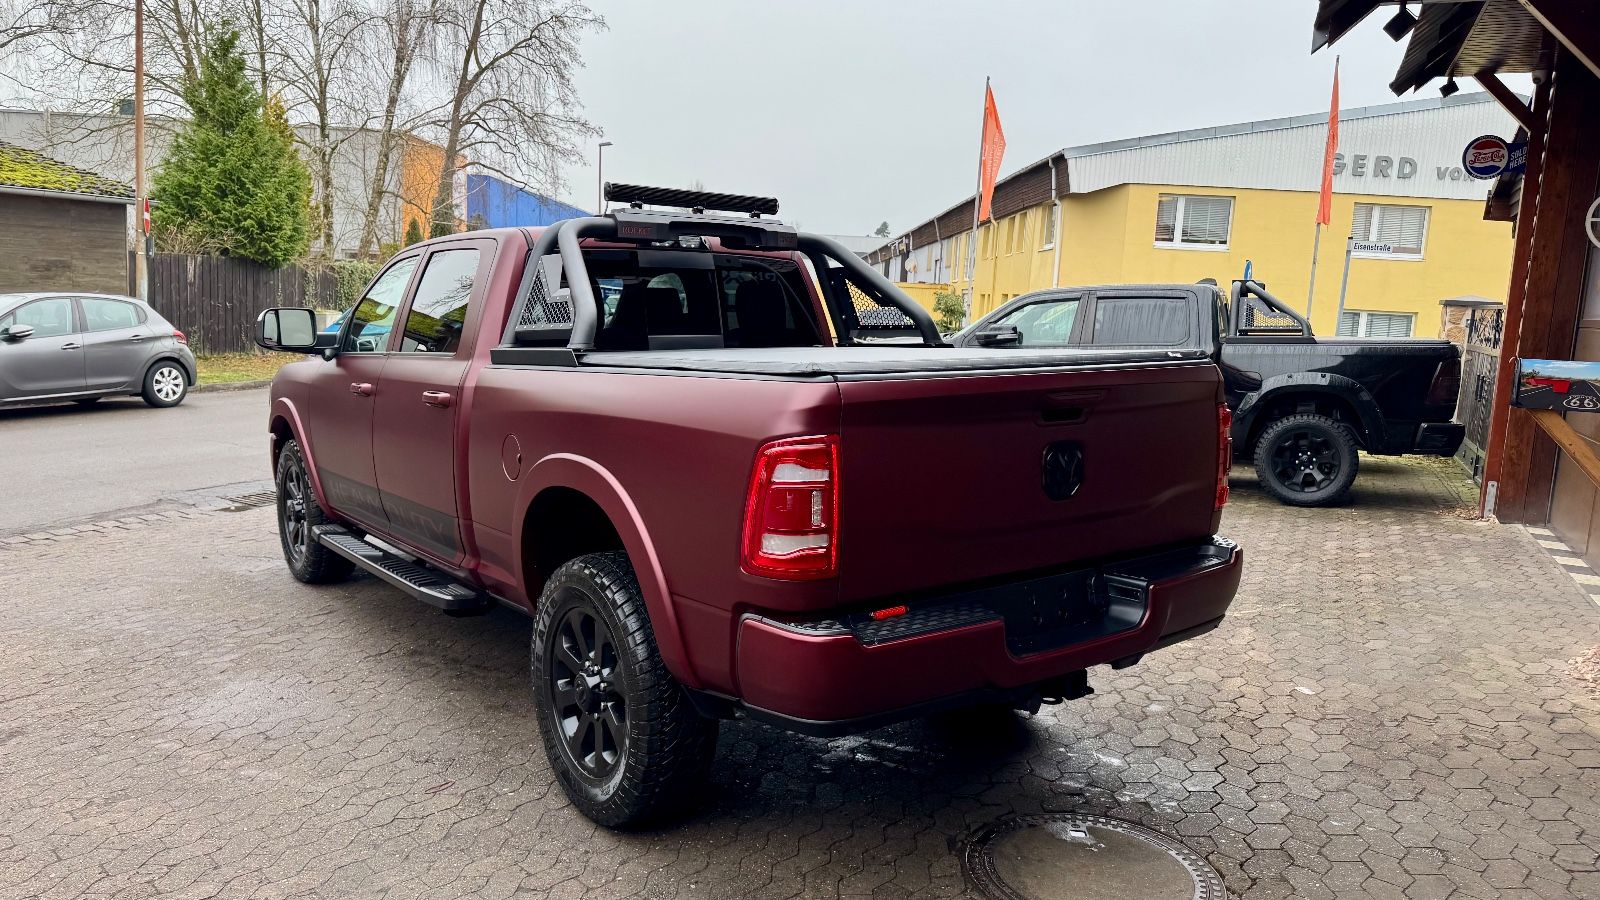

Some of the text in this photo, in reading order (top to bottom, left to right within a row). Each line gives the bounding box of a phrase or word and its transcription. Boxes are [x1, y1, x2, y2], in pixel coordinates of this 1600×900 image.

[1511, 147, 1528, 160] SOLD
[1333, 153, 1418, 179] GERD
[1510, 155, 1526, 169] HERE
[1353, 242, 1391, 252] Eisenstraße
[1570, 397, 1594, 408] 66
